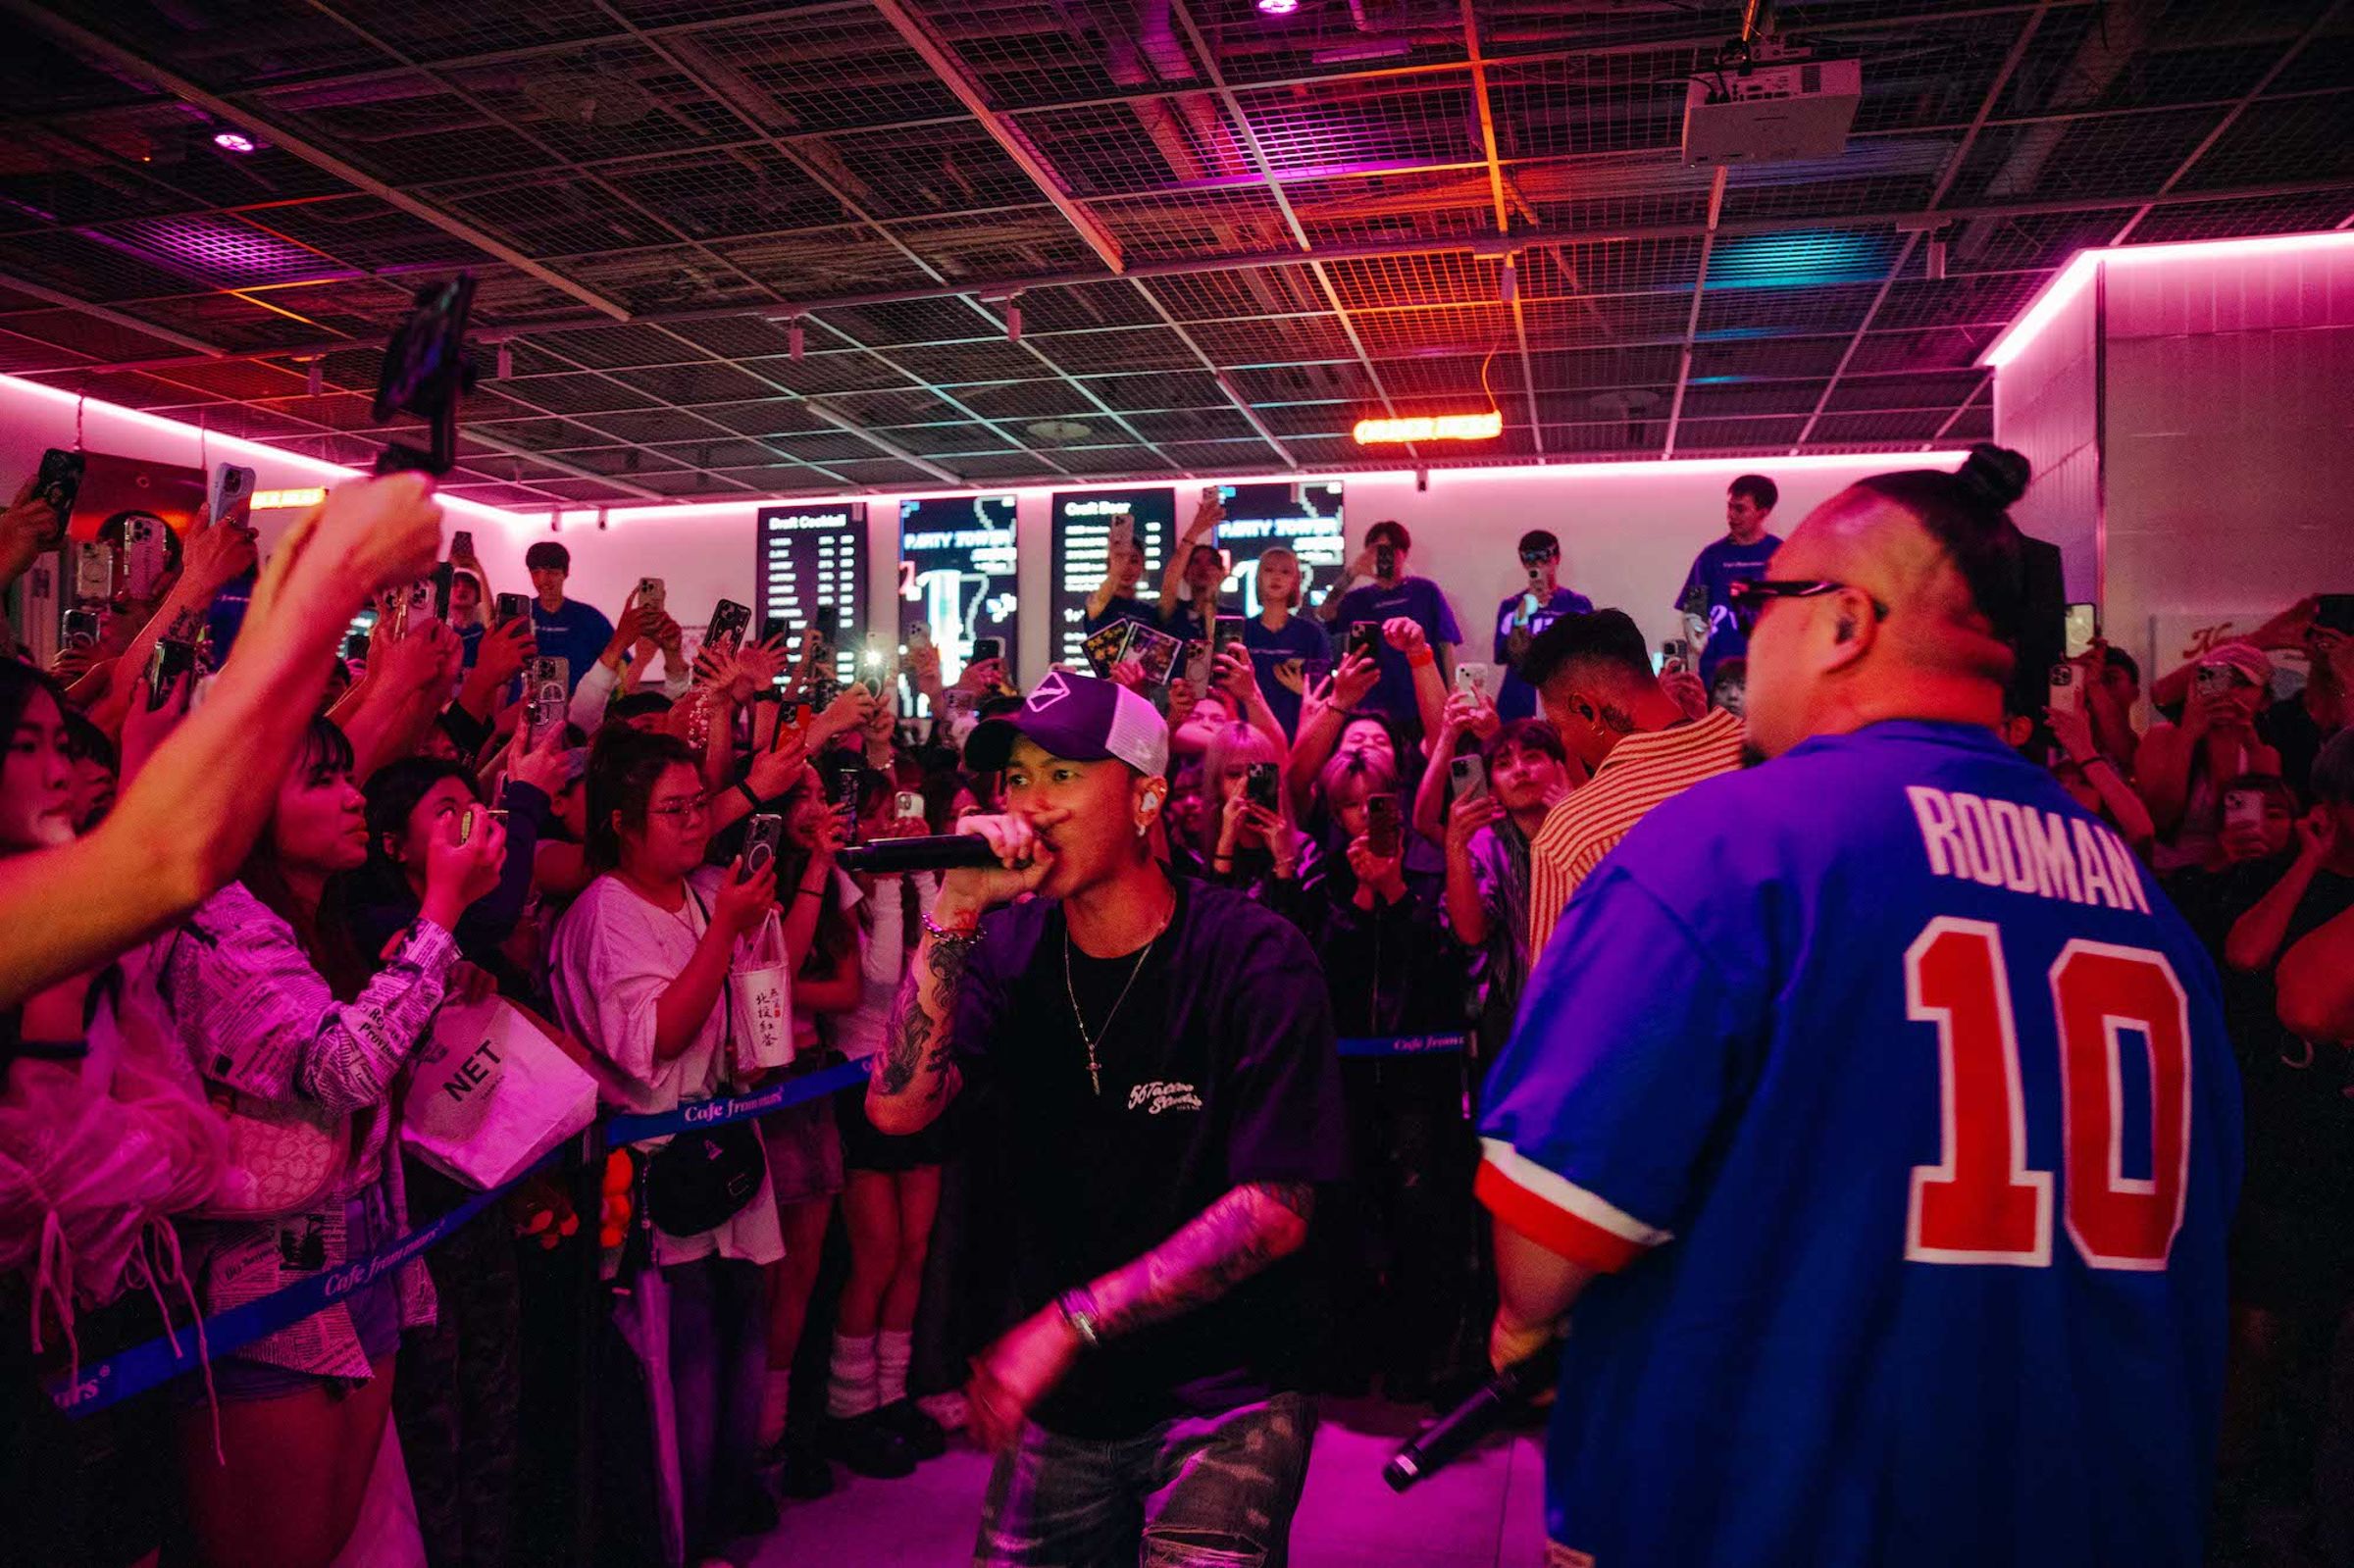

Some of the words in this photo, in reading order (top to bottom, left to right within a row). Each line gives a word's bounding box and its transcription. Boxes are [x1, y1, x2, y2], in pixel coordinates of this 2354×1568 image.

[903, 531, 954, 550] PARTY
[1906, 784, 2151, 915] RODMAN
[443, 1039, 501, 1102] NET
[1903, 915, 2192, 1272] 10
[685, 1102, 723, 1122] Cafe
[326, 1264, 365, 1295] Cafe
